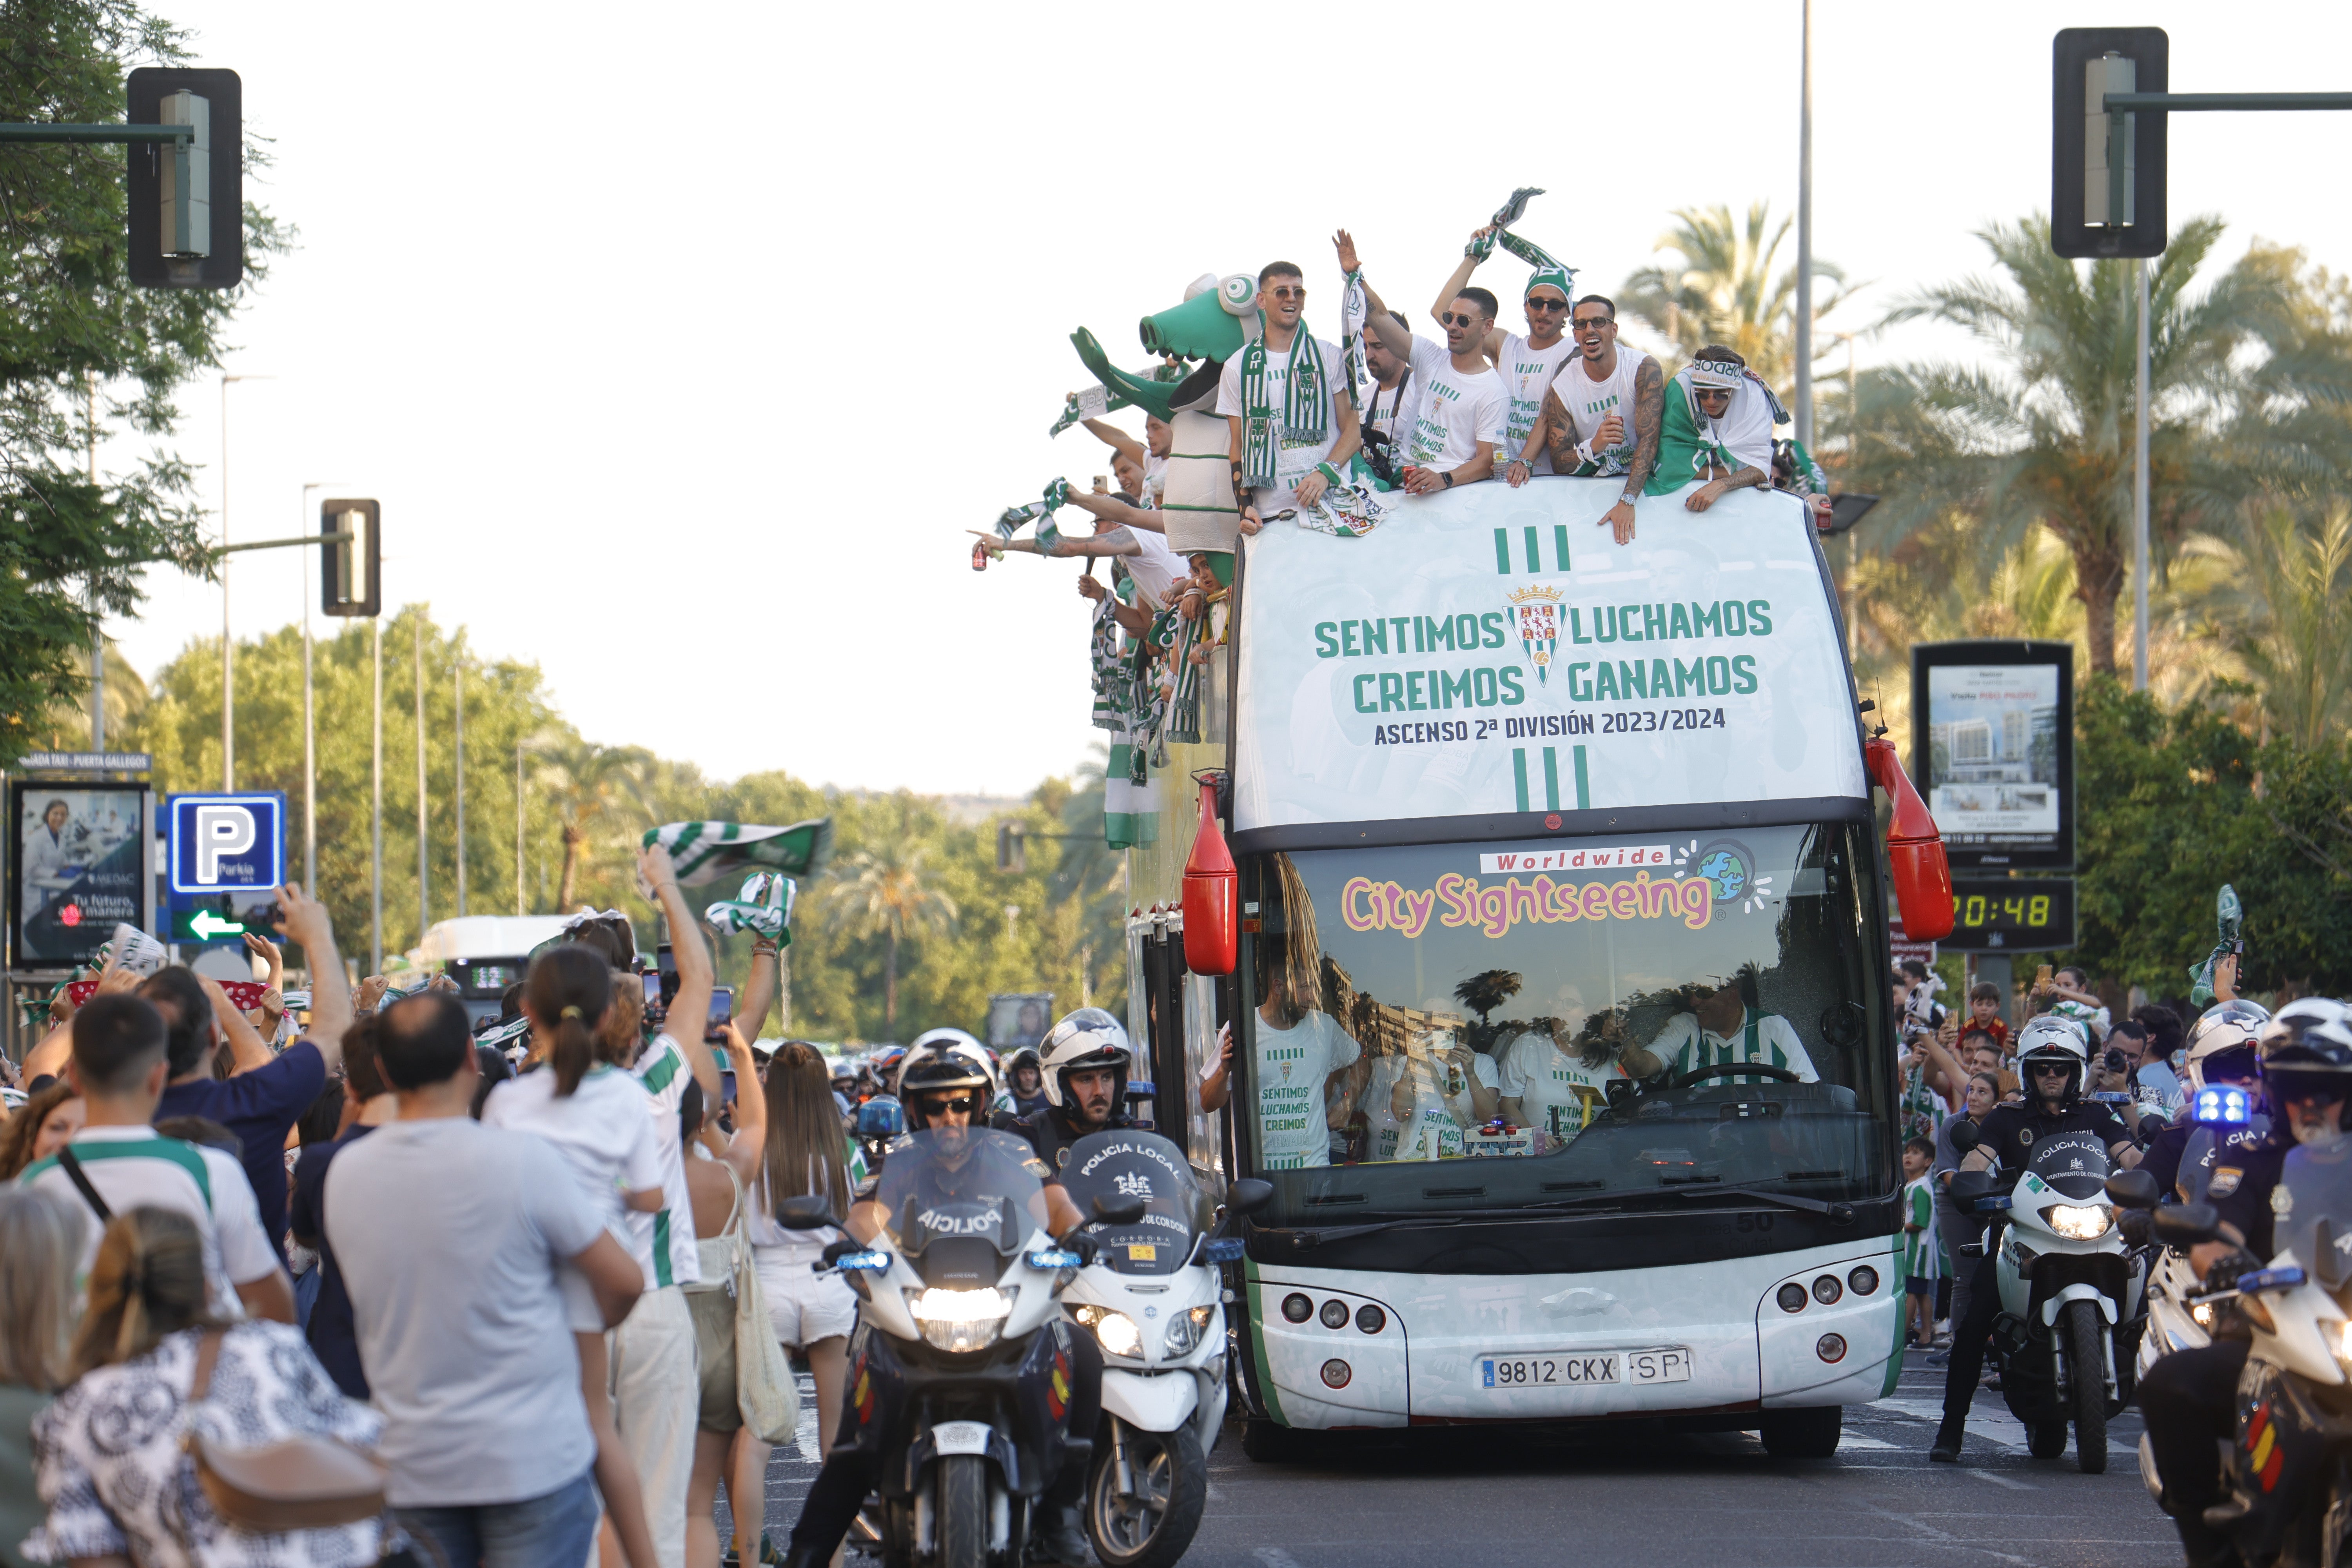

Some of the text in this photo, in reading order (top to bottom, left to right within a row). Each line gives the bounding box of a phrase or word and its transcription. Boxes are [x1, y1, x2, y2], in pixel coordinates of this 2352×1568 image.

[1693, 360, 1741, 381] ÓRDOB
[1279, 450, 1325, 468] GANAMOS
[1315, 600, 1772, 659] SENTIMOS LUCHAMOS
[1354, 655, 1757, 713] CREIMOS GANAMOS
[1375, 720, 1468, 746] ASCENSO
[1505, 710, 1594, 739] DIVISIÓN
[1602, 708, 1726, 733] 2023/2024
[74, 754, 103, 768] PUERTA
[105, 755, 146, 768] GALLEGOS
[196, 805, 256, 884] P
[1497, 849, 1664, 870] Worldwide
[1953, 895, 2050, 927] 0:48
[1262, 1087, 1309, 1100] SENTIMOS
[1260, 1102, 1310, 1115] LUCHAMOS
[1265, 1118, 1306, 1131] CREIMOS
[2037, 1141, 2111, 1167] POLICIA LOCAL
[2200, 1130, 2257, 1167] POCIA
[1081, 1143, 1180, 1180] POLICIA LOCAL
[2046, 1171, 2080, 1181] AYUNTAMIENTO
[2087, 1172, 2107, 1180] CORDOBA
[1146, 1214, 1155, 1225] DE
[1156, 1214, 1189, 1237] CORDOBA
[1499, 1357, 1614, 1384] 9812 CKX
[1638, 1354, 1680, 1379] SP
